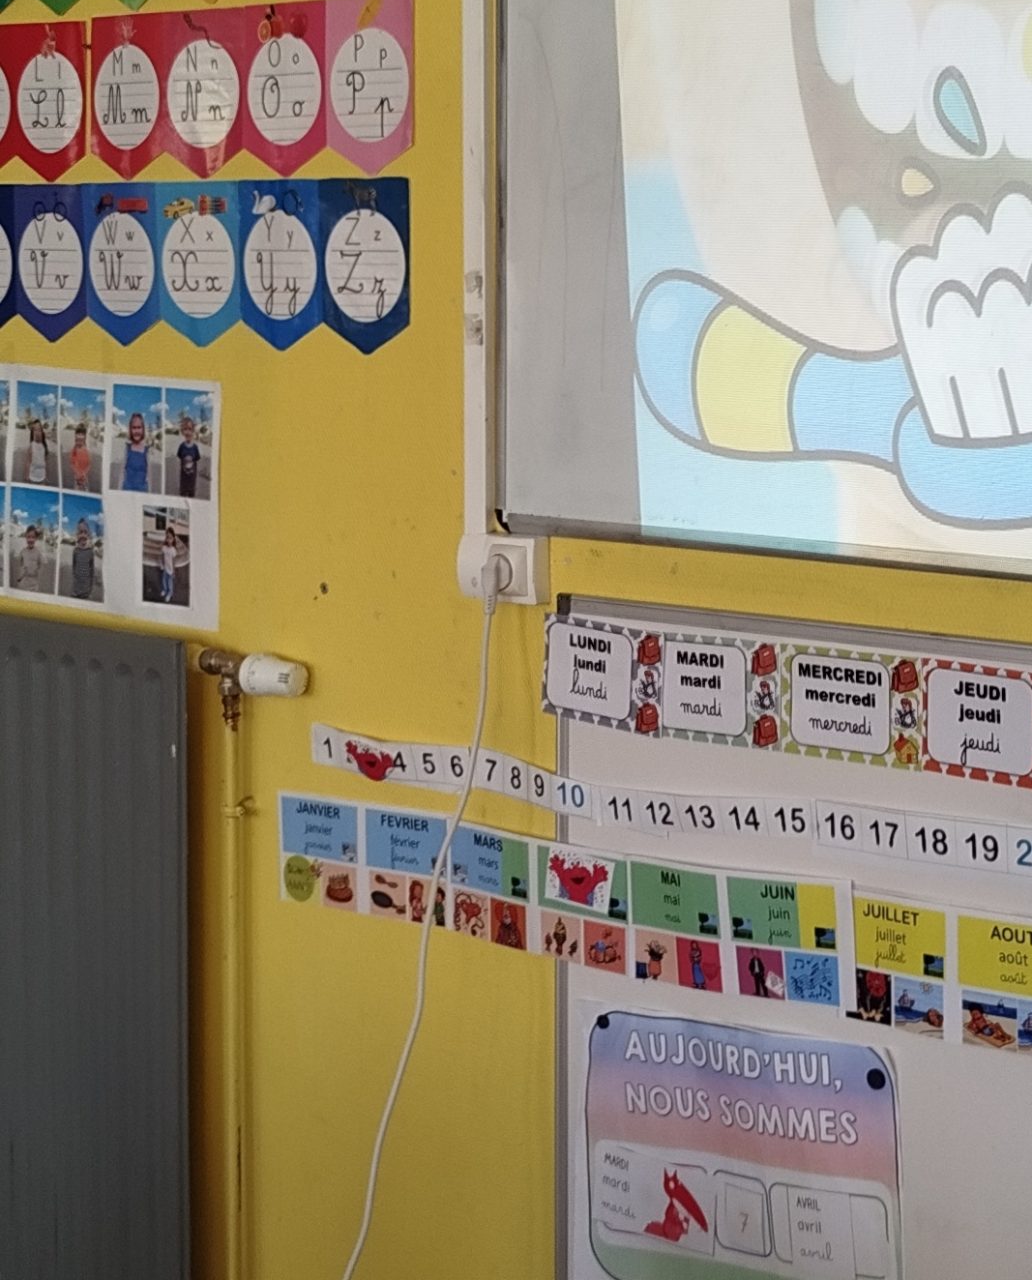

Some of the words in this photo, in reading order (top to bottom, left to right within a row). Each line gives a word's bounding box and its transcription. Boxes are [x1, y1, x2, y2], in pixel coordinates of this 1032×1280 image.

[187, 46, 197, 71] N
[268, 40, 281, 68] O
[354, 34, 364, 62] P
[35, 57, 44, 82] L
[113, 50, 123, 76] M
[132, 64, 141, 74] m
[30, 90, 48, 128] L
[56, 88, 66, 128] l
[103, 84, 126, 124] M
[132, 108, 151, 124] m
[181, 80, 201, 122] N
[208, 104, 225, 120] n
[262, 76, 280, 118] O
[292, 101, 304, 117] o
[346, 71, 365, 115] P
[374, 96, 394, 138] p
[34, 220, 46, 244] V
[102, 220, 118, 244] W
[126, 232, 134, 241] w
[180, 218, 196, 244] X
[264, 217, 274, 242] Y
[346, 218, 360, 246] Z
[30, 250, 48, 288] V
[55, 274, 70, 288] v
[99, 251, 124, 290] W
[125, 276, 143, 290] w
[171, 251, 200, 292] X
[205, 276, 222, 292] x
[257, 252, 277, 316] Y
[284, 277, 300, 316] y
[337, 250, 364, 294] Z
[371, 277, 388, 318] z
[569, 633, 612, 654] LUNDI
[573, 654, 606, 674] lundi
[676, 651, 724, 669] MARDI
[680, 673, 721, 690] mardi
[798, 662, 882, 686] MERCREDI
[570, 670, 608, 701] lundi
[954, 680, 1006, 702] JEUDI
[680, 698, 722, 718] mardi
[804, 687, 876, 708] mercredi
[808, 713, 873, 737] mercredi
[958, 704, 1002, 725] jeudi
[960, 732, 1002, 766] jeudi
[296, 802, 340, 819] JANVIER
[324, 737, 332, 758] 1
[393, 752, 406, 772] 4
[422, 752, 436, 774] 5
[450, 754, 464, 778] 6
[485, 758, 498, 782] 7
[510, 766, 522, 790] 8
[534, 774, 544, 798] 9
[556, 782, 584, 808] 10
[608, 796, 632, 822] 11
[646, 800, 674, 826] 12
[685, 806, 715, 829] 13
[728, 806, 760, 831] 14
[774, 807, 806, 833] 15
[824, 812, 855, 840] 16
[869, 820, 899, 848] 17
[915, 827, 948, 855] 18
[965, 833, 999, 862] 19
[381, 814, 429, 832] FEVRIER
[474, 834, 502, 852] MARS
[479, 857, 498, 870] mars
[660, 871, 680, 886] MAI
[664, 894, 680, 906] mai
[760, 884, 794, 900] JUIN
[768, 906, 790, 922] juin
[863, 903, 919, 926] JUILLET
[768, 926, 792, 945] juin
[874, 926, 906, 946] juillet
[874, 946, 906, 968] juillet
[998, 950, 1028, 967] août
[1000, 970, 1028, 986] août
[624, 1082, 710, 1122] NOUS
[720, 1095, 858, 1146] SOMMES
[604, 1153, 629, 1171] MARDI
[602, 1176, 630, 1192] mardi
[796, 1196, 821, 1212] AVRIL
[739, 1212, 748, 1232] 7
[798, 1220, 822, 1234] avril
[800, 1242, 833, 1261] avril
